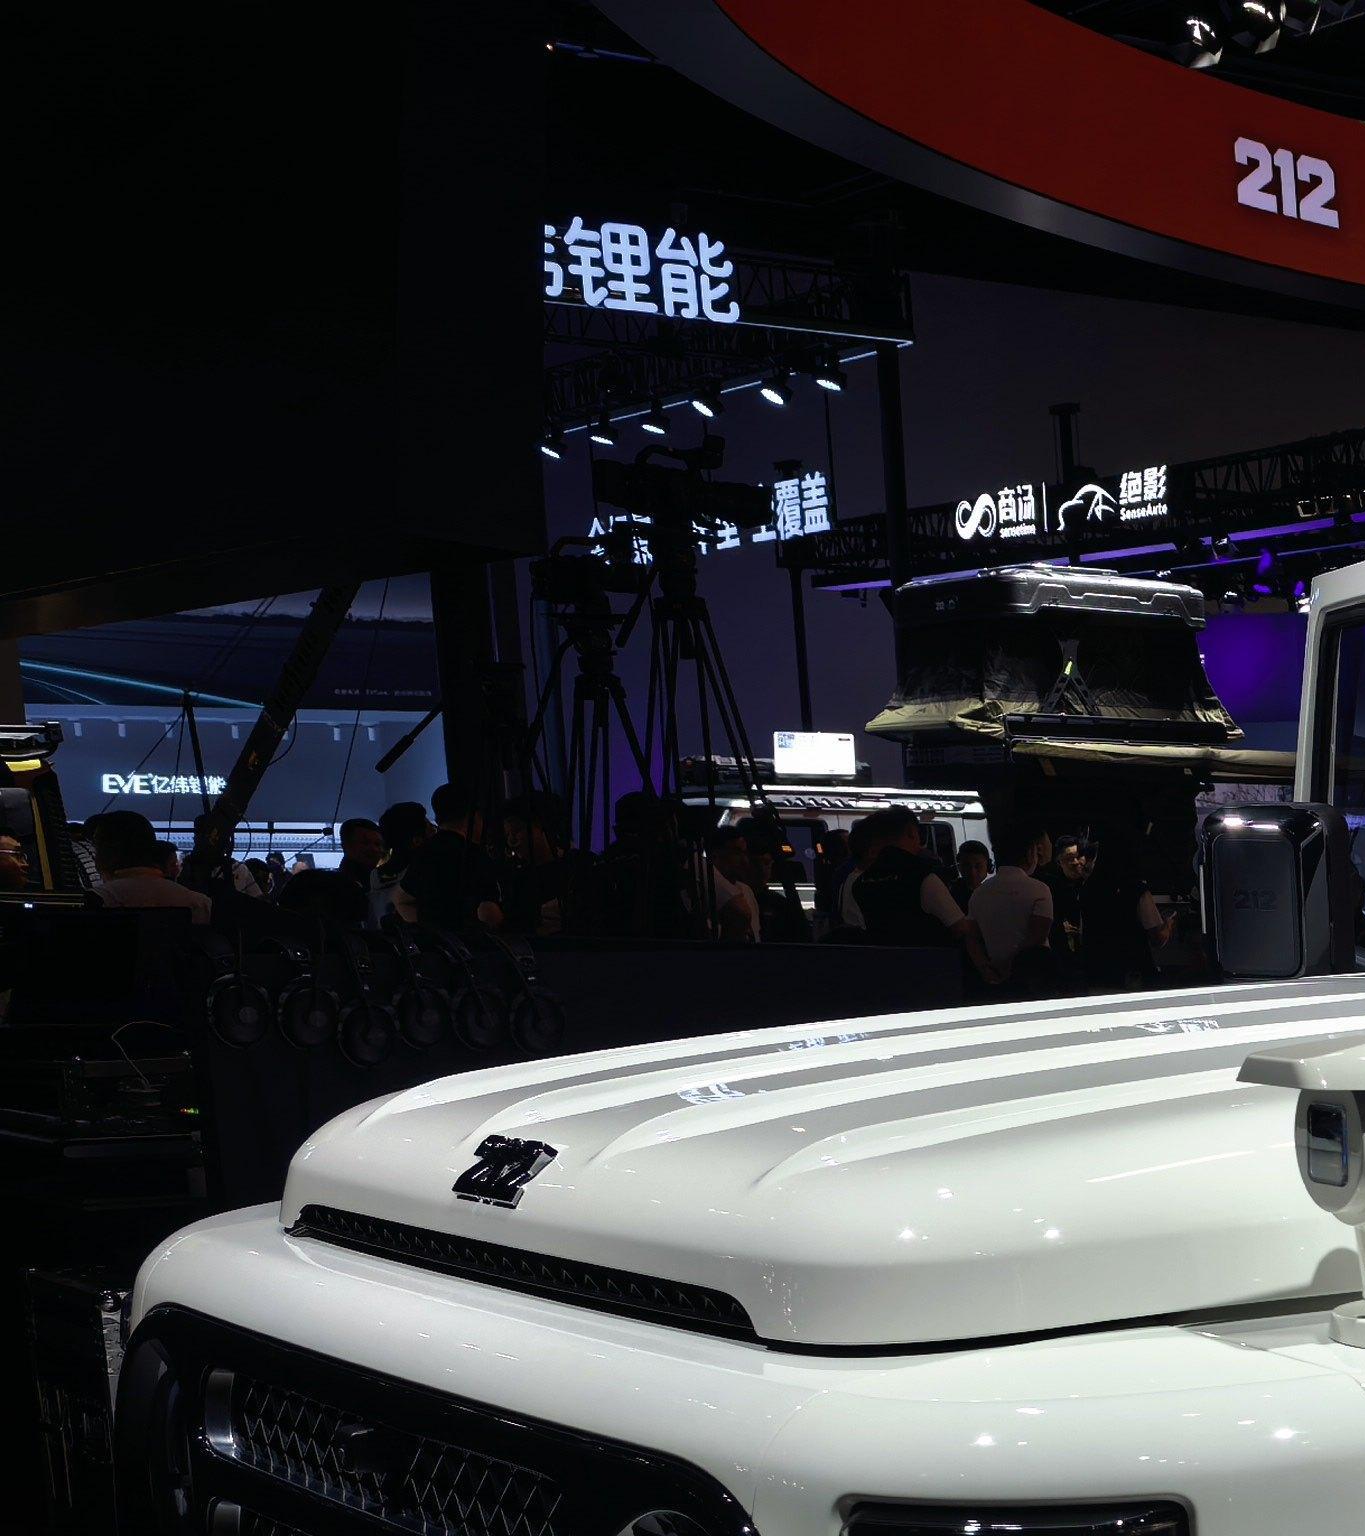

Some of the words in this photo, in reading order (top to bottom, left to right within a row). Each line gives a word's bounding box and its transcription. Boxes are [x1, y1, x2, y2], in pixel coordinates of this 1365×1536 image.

[1234, 136, 1340, 229] 212
[998, 485, 1035, 523] 商汤
[1119, 465, 1167, 505] 绝影
[102, 773, 152, 795] EVE
